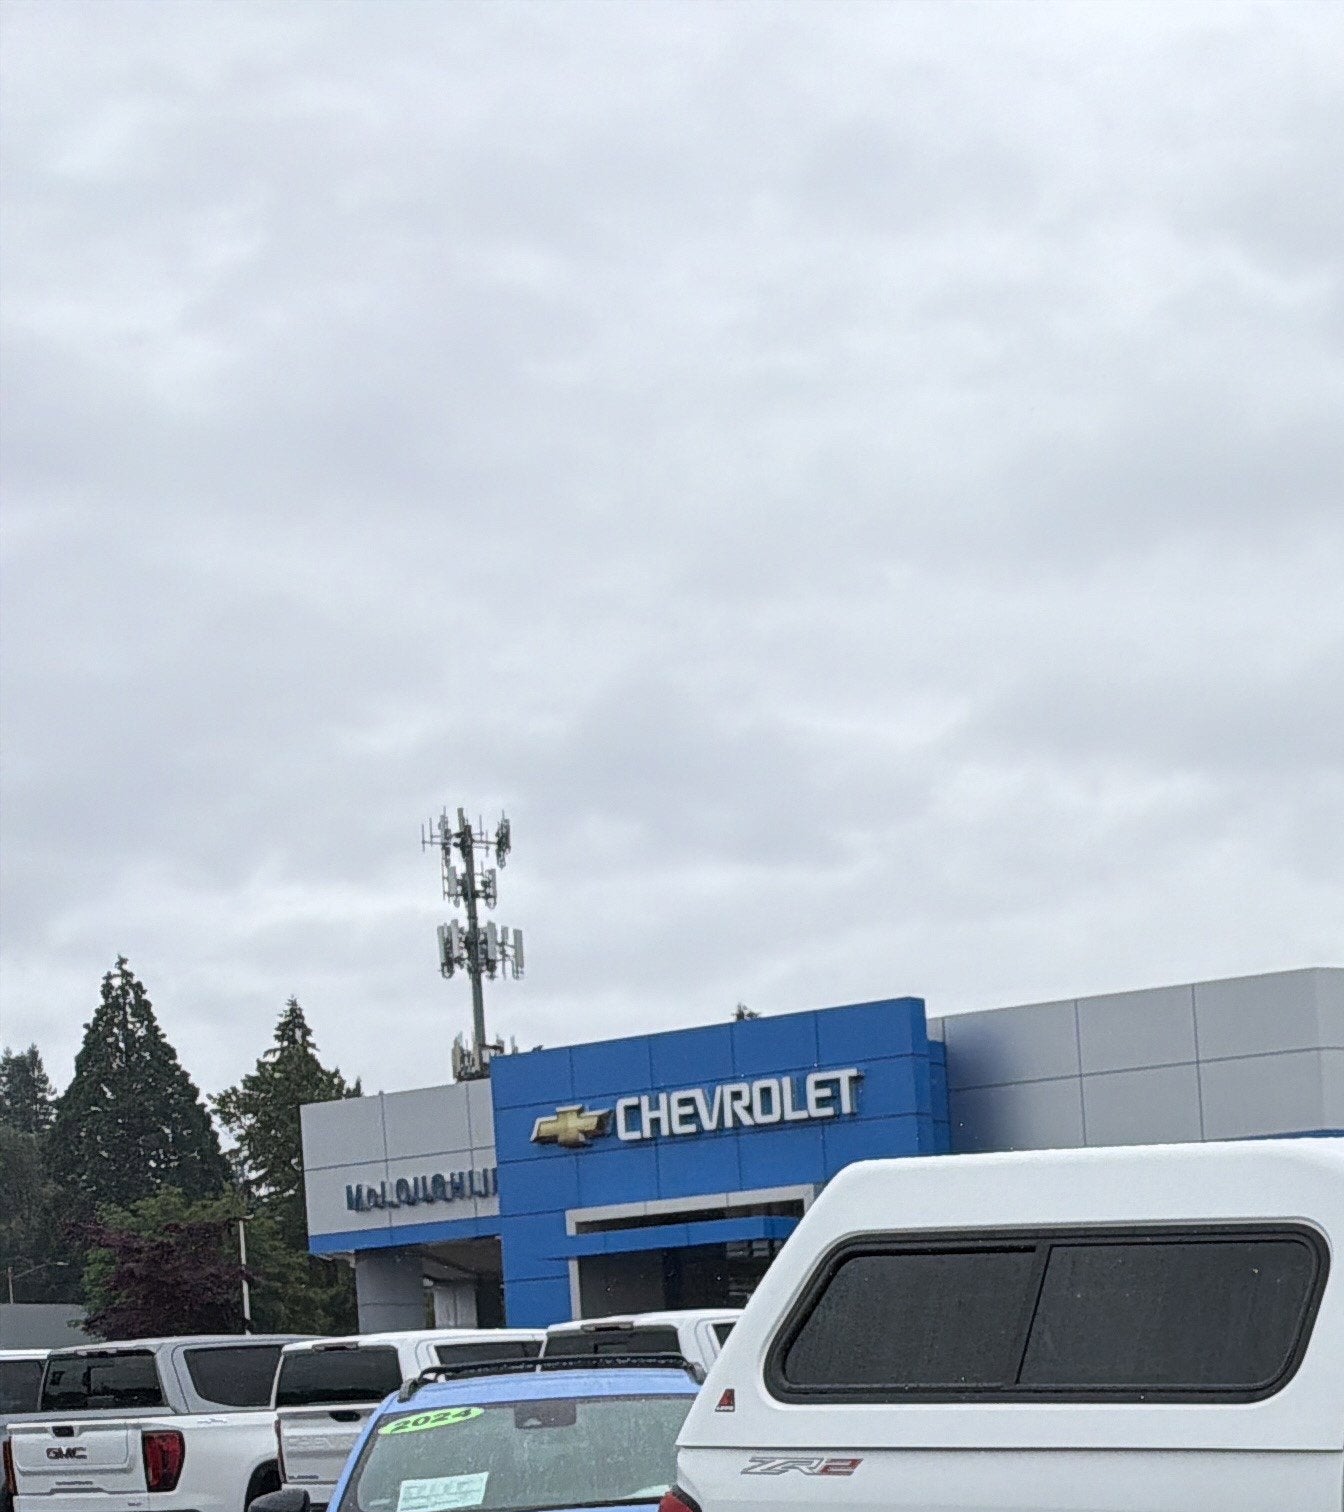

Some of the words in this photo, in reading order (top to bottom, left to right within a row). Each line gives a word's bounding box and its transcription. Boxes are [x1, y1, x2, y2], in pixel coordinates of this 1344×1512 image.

[616, 1068, 859, 1140] CHEVROLET
[390, 1408, 472, 1432] 2024
[46, 1447, 87, 1460] GMC
[741, 1457, 863, 1475] ZR2
